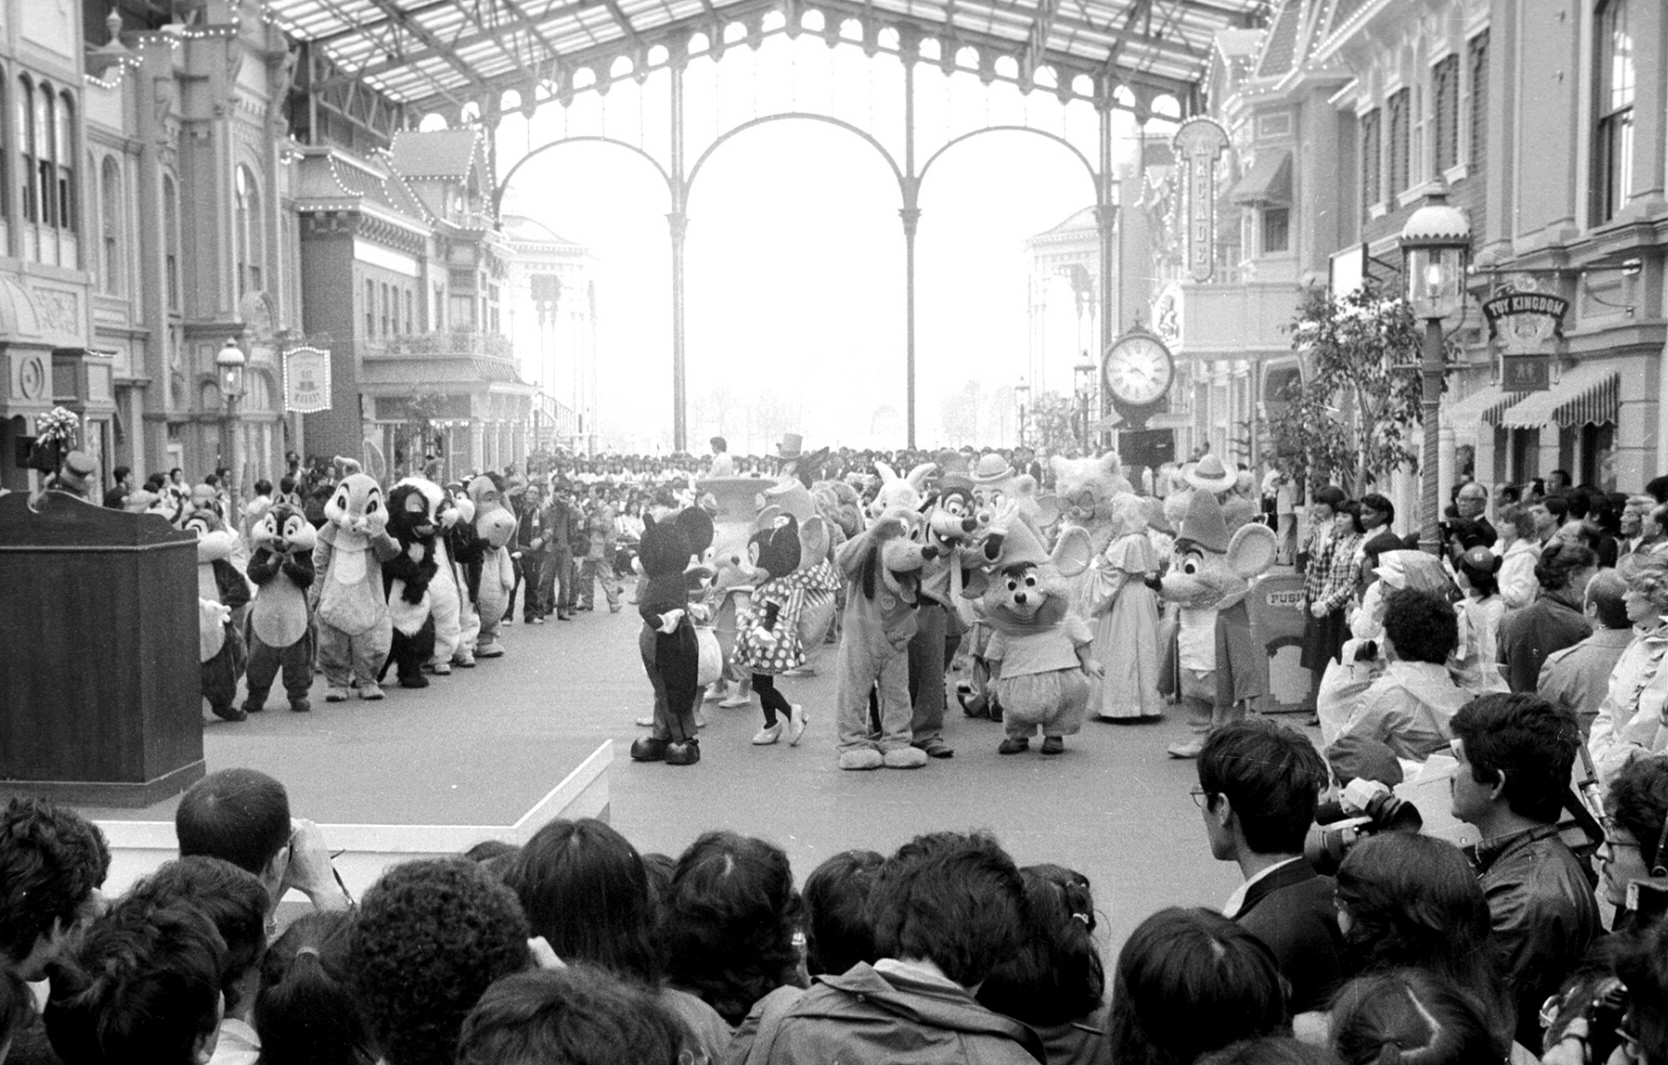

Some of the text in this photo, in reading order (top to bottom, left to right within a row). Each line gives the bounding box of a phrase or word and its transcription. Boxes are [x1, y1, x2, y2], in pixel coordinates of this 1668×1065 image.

[1195, 138, 1208, 265] ARCADE
[1488, 296, 1565, 316] TOY KINGDOM
